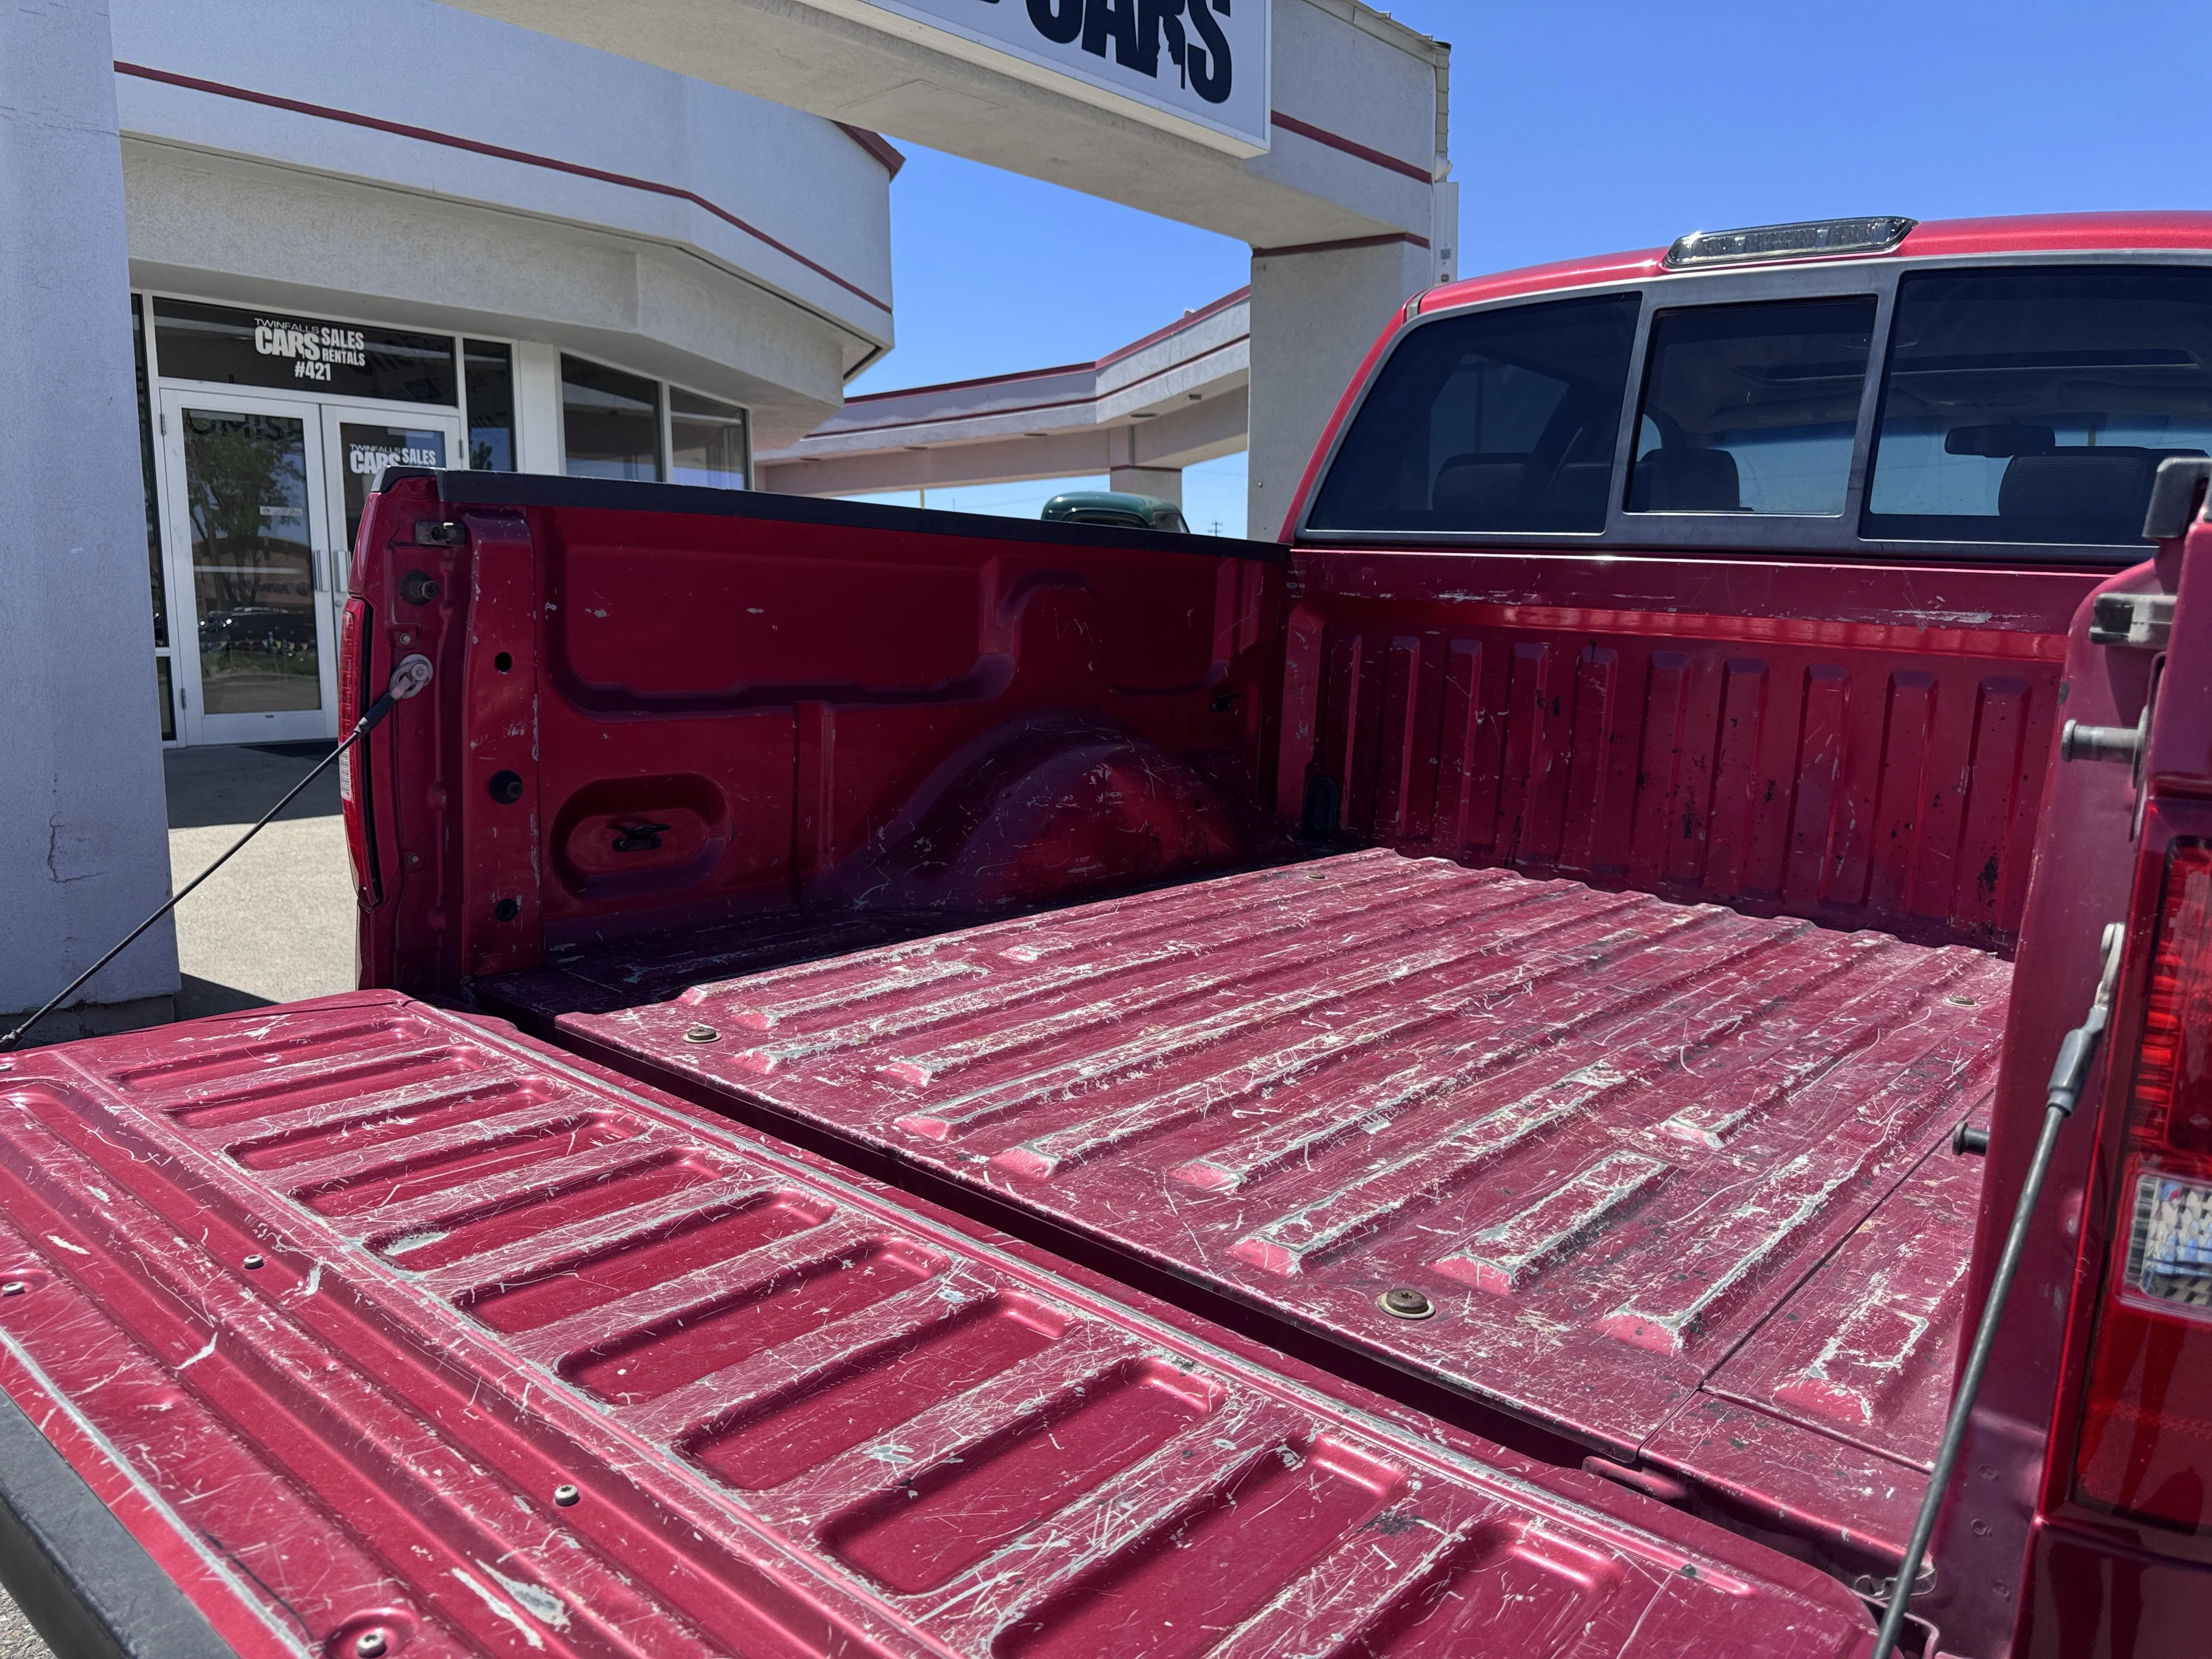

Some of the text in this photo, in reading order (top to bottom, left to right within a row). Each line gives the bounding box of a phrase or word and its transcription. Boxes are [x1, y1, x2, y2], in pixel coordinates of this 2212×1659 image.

[255, 326, 321, 361] CARS
[321, 327, 365, 351] SALES
[322, 348, 365, 366] RENTALS
[295, 360, 331, 381] #421
[402, 448, 436, 465] SALES
